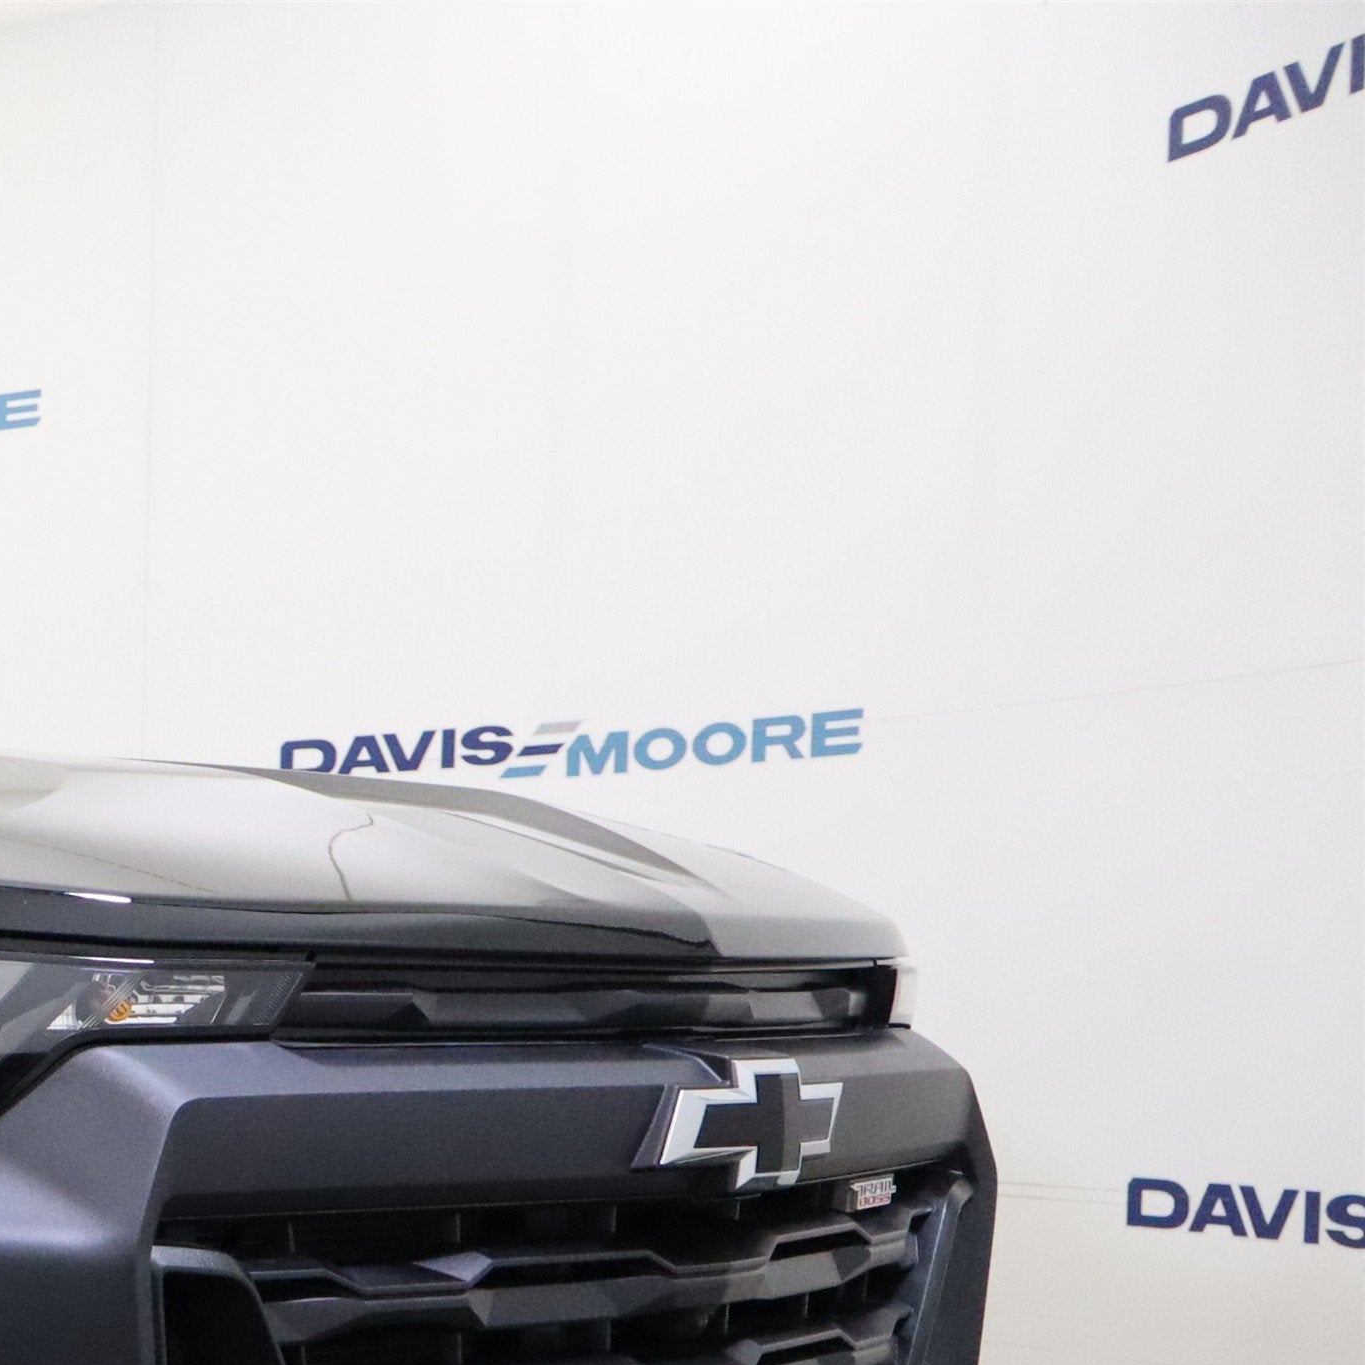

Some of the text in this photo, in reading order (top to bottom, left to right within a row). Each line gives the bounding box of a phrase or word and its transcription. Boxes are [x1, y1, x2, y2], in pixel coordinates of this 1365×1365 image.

[279, 707, 864, 778] DAVIS MOORE
[850, 1178, 896, 1197] TRAIL
[1126, 1177, 1365, 1249] DAVIS
